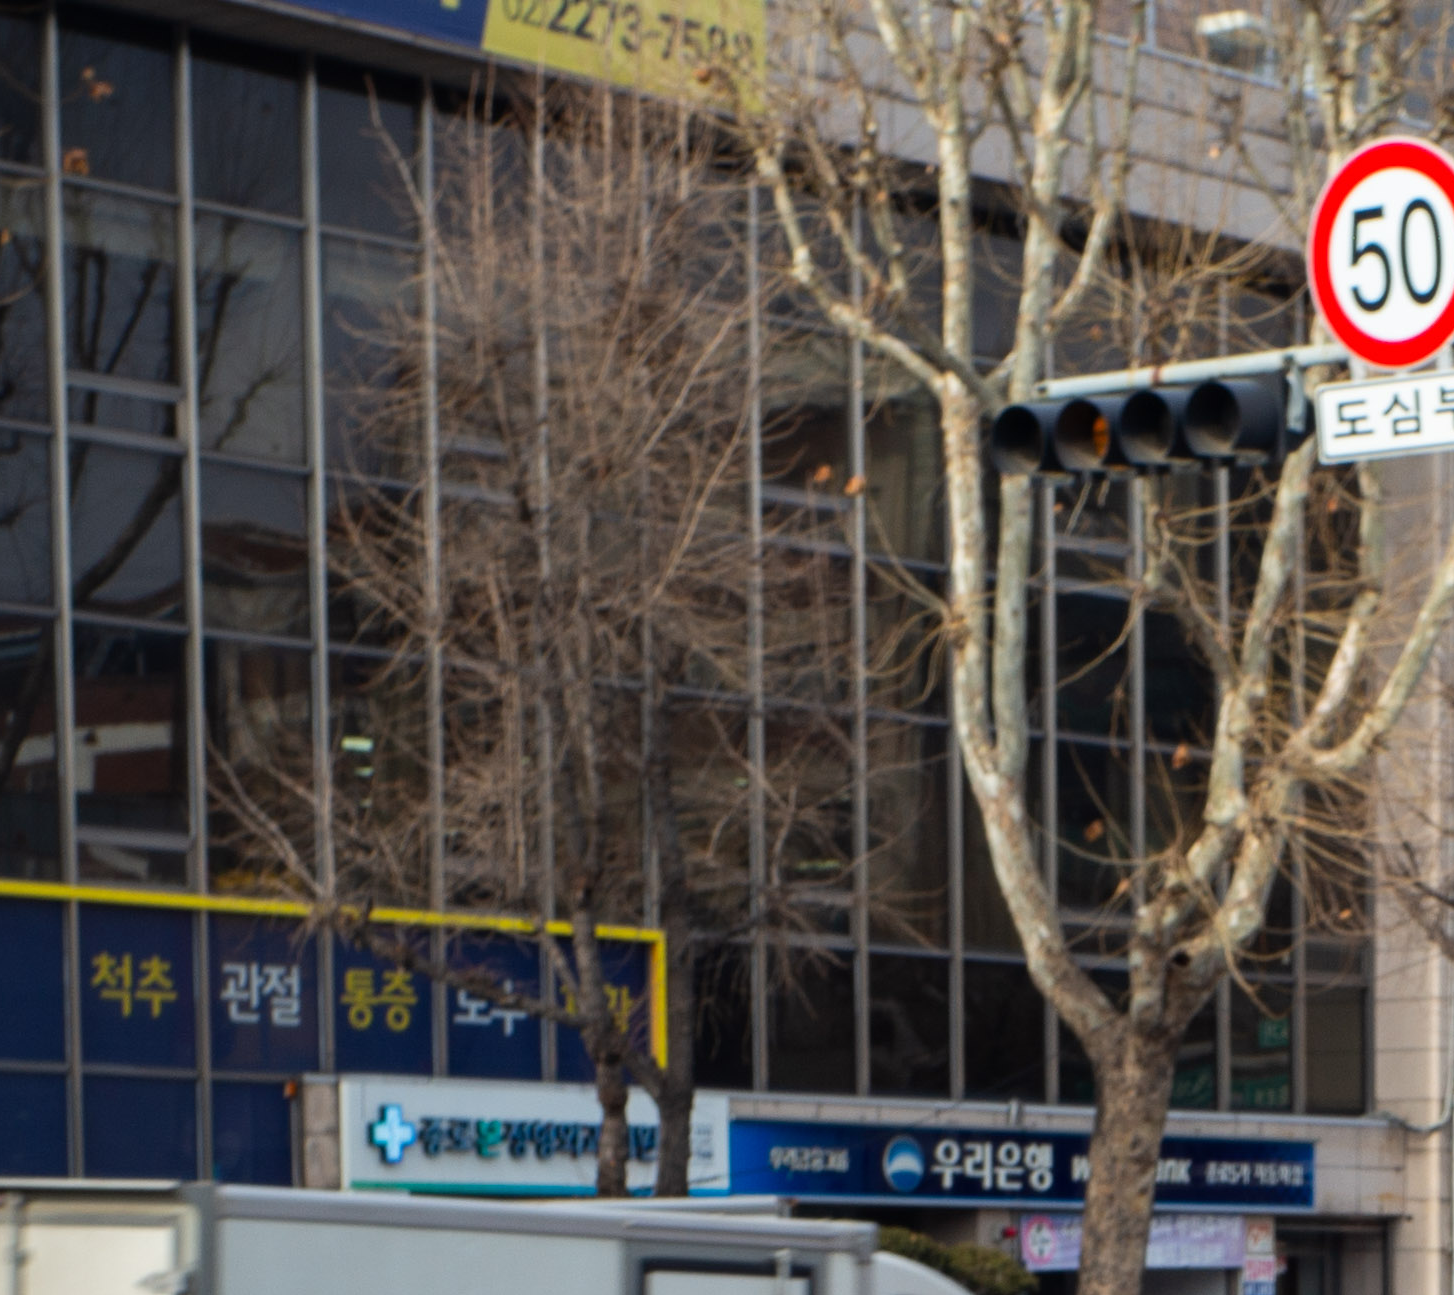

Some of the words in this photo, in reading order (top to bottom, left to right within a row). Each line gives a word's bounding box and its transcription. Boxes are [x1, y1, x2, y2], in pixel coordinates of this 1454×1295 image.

[1350, 196, 1444, 314] 50
[91, 951, 178, 1018] 척추
[219, 961, 302, 1027] 관절
[341, 967, 417, 1031] 통증
[931, 1138, 1054, 1192] 우리은행
